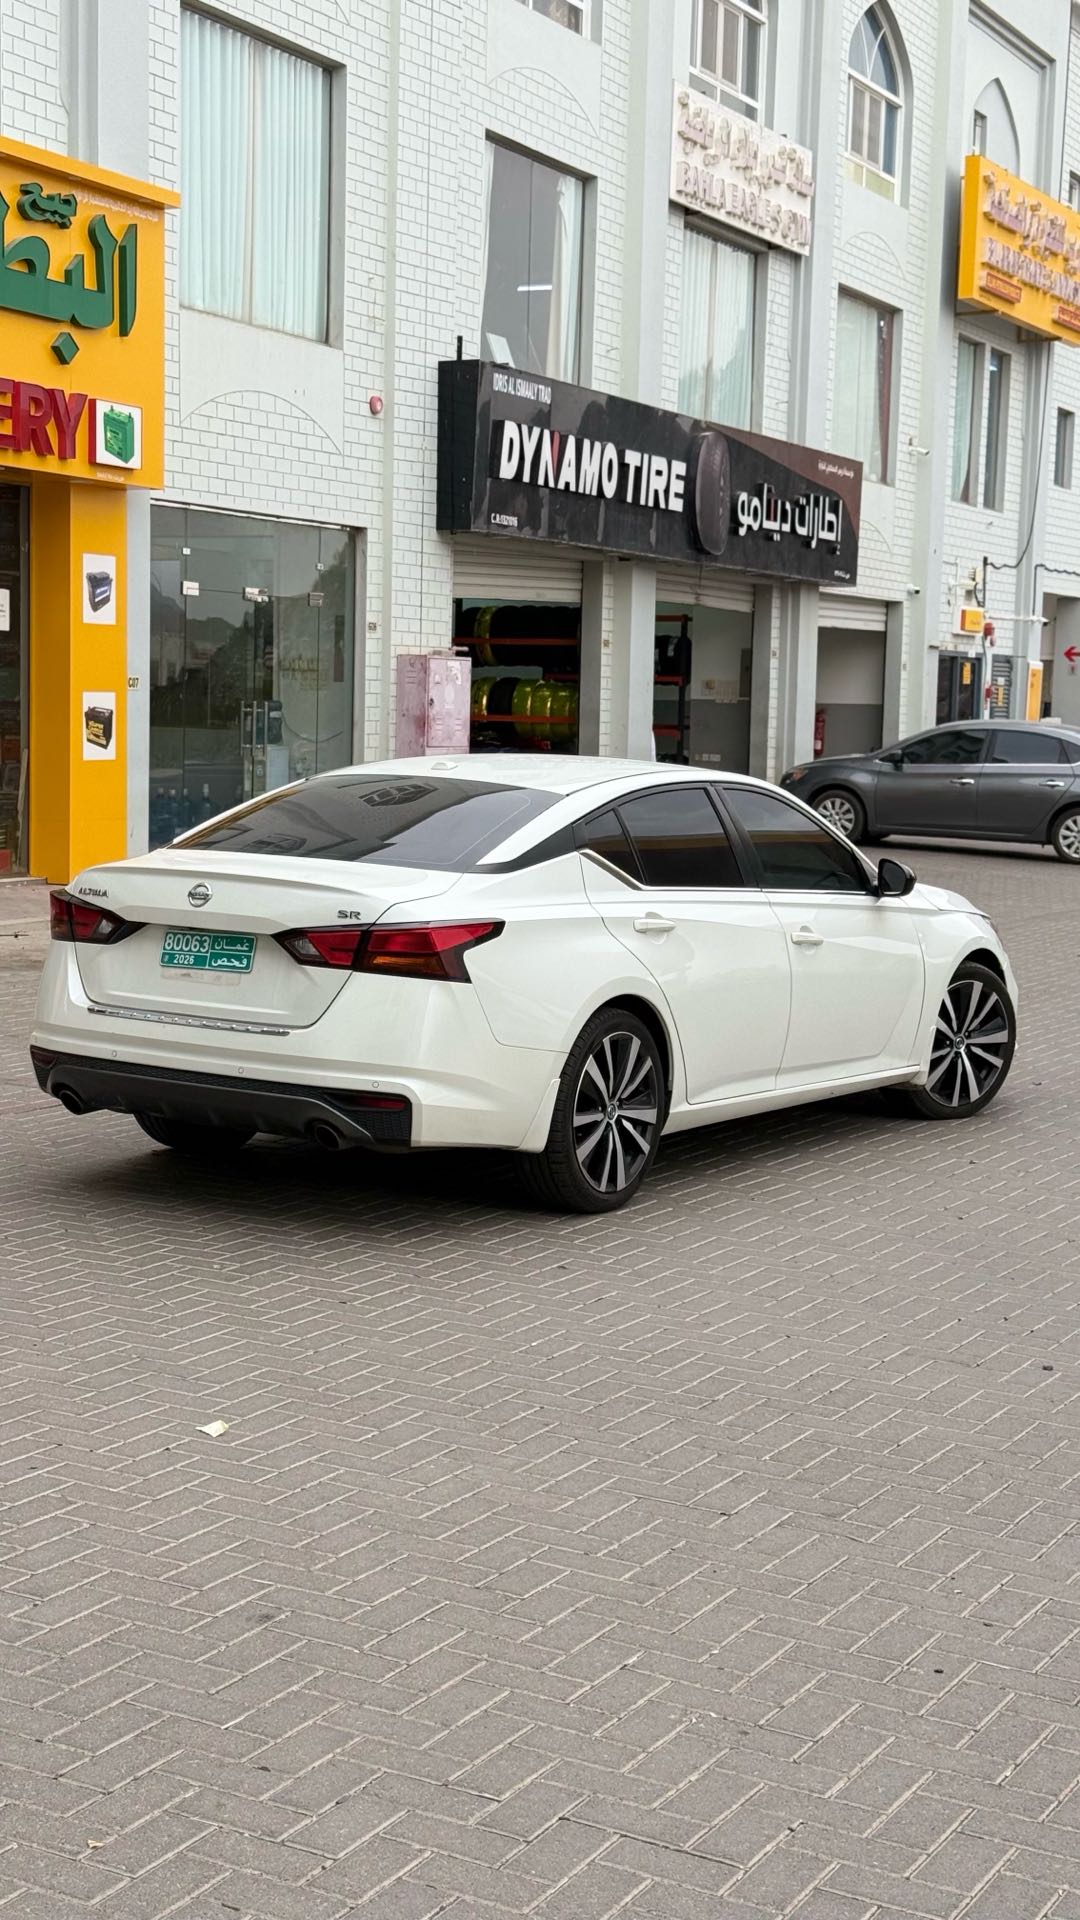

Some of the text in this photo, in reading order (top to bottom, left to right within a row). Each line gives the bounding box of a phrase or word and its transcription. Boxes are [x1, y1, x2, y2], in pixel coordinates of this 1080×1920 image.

[676, 161, 726, 211] BAHLA
[726, 183, 782, 234] EAGLES
[493, 372, 508, 393] IDRIS
[508, 376, 515, 395] AL
[499, 420, 687, 513] DYNAMO TIRE
[795, 492, 843, 556] إطارات
[78, 887, 108, 898] ALTIMA
[337, 909, 361, 920] SR
[164, 933, 210, 953] 80063
[173, 954, 195, 965] 2026
[212, 955, 248, 967] فحص
